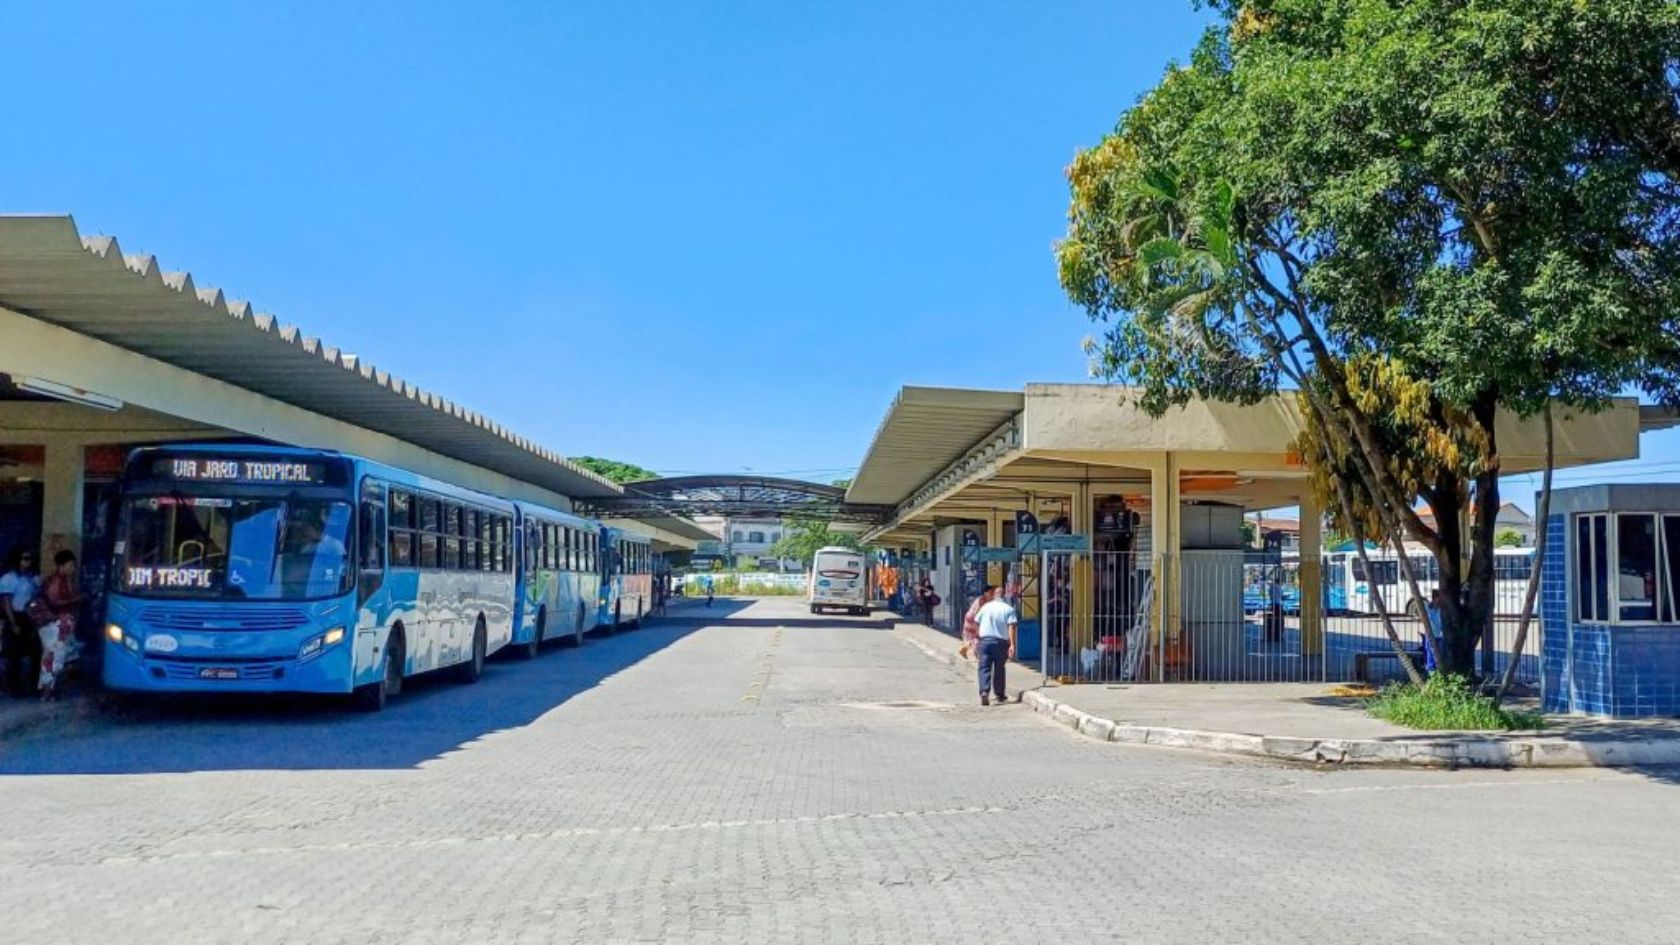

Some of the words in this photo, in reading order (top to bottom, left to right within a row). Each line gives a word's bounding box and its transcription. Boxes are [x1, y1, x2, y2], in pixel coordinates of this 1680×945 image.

[174, 460, 196, 477] VIA
[201, 461, 237, 478] JARD
[245, 462, 311, 481] TROPICAL
